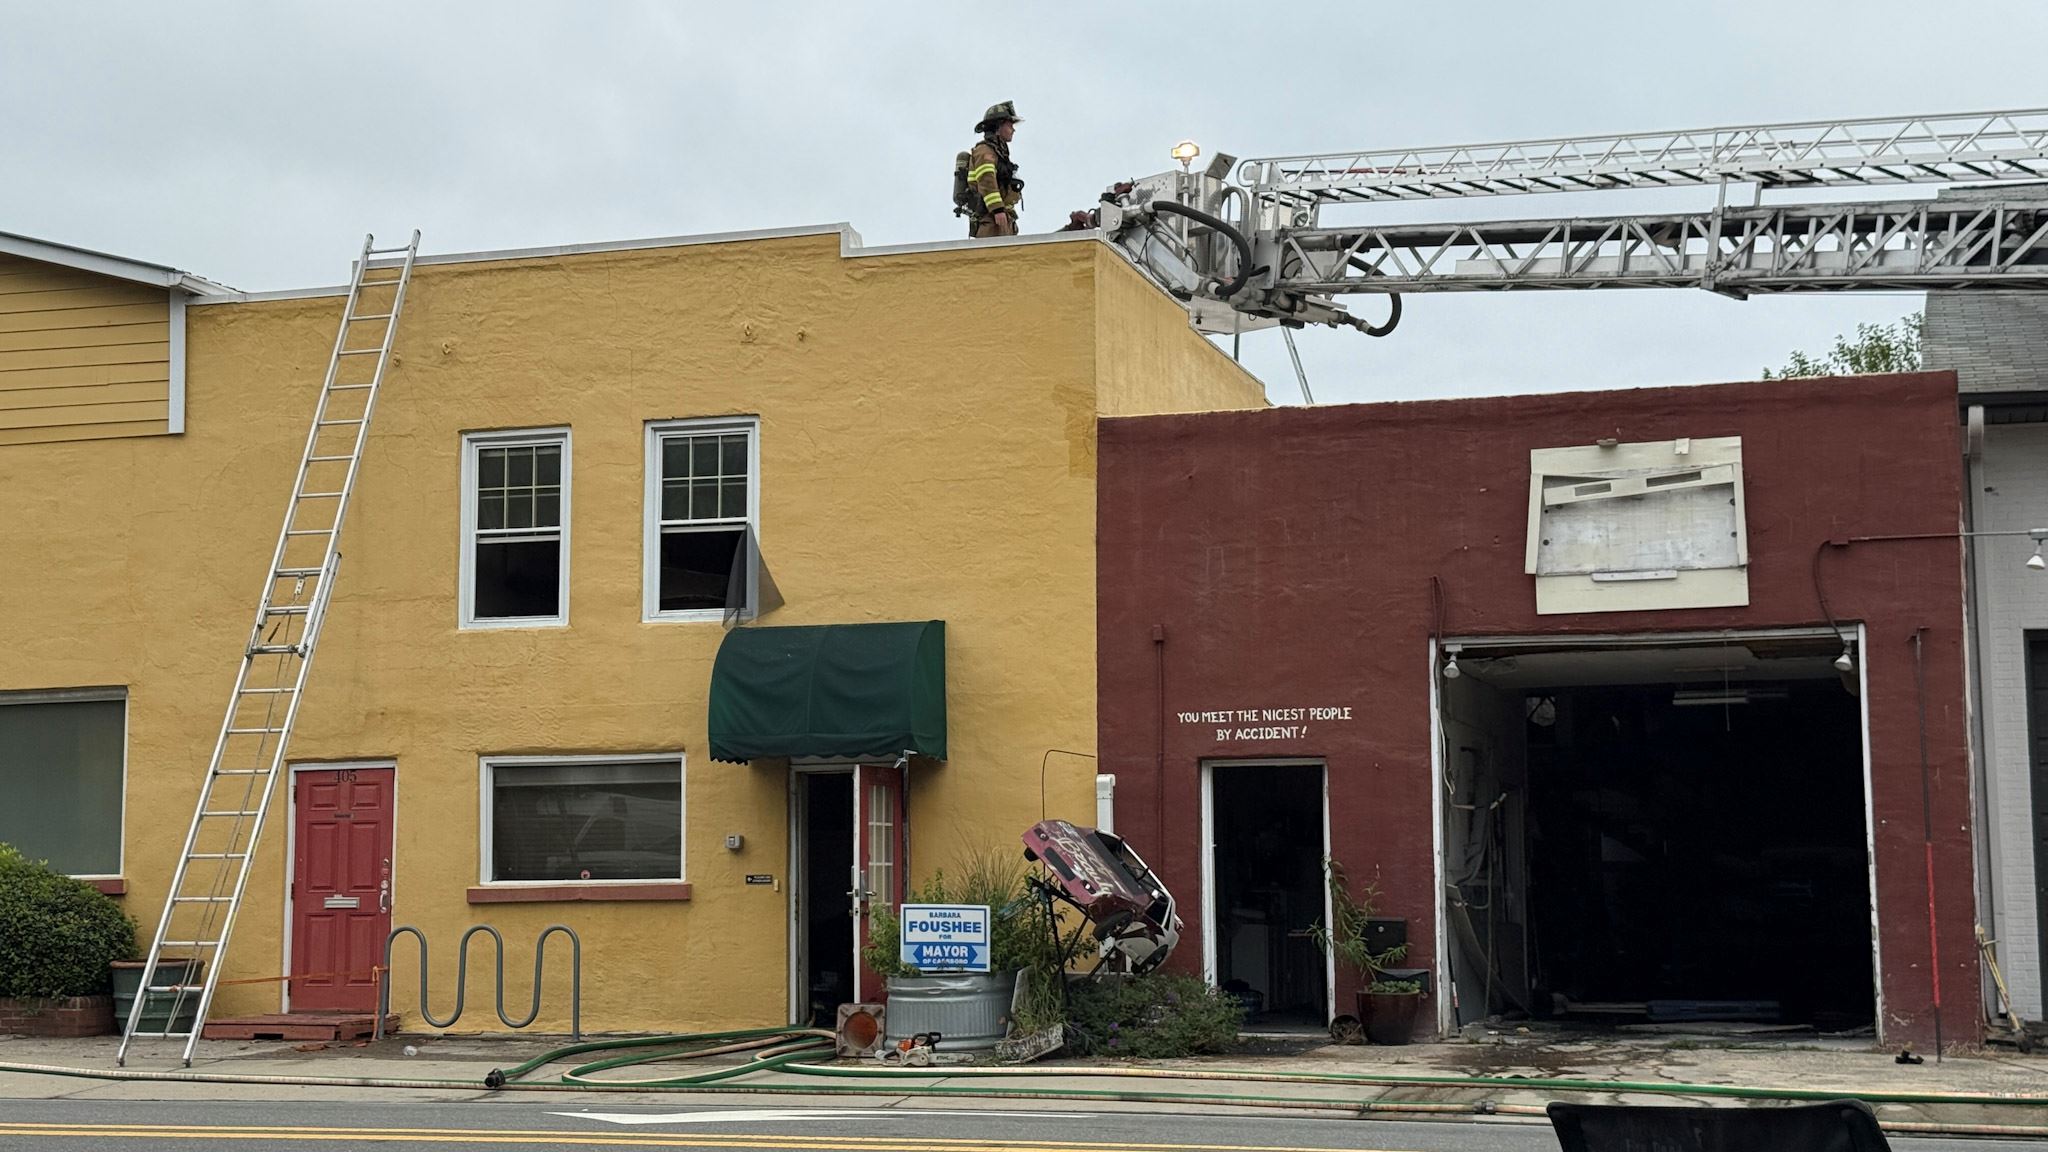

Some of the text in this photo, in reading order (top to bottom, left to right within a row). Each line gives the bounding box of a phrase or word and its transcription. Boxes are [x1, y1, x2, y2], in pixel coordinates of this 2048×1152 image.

[1177, 707, 1352, 723] YOU MEET THE NICEST PEOPLE
[1216, 729, 1231, 741] BY
[929, 911, 961, 919] BARBARA
[908, 921, 982, 933] FOUSHEE
[922, 945, 969, 957] MAYOR
